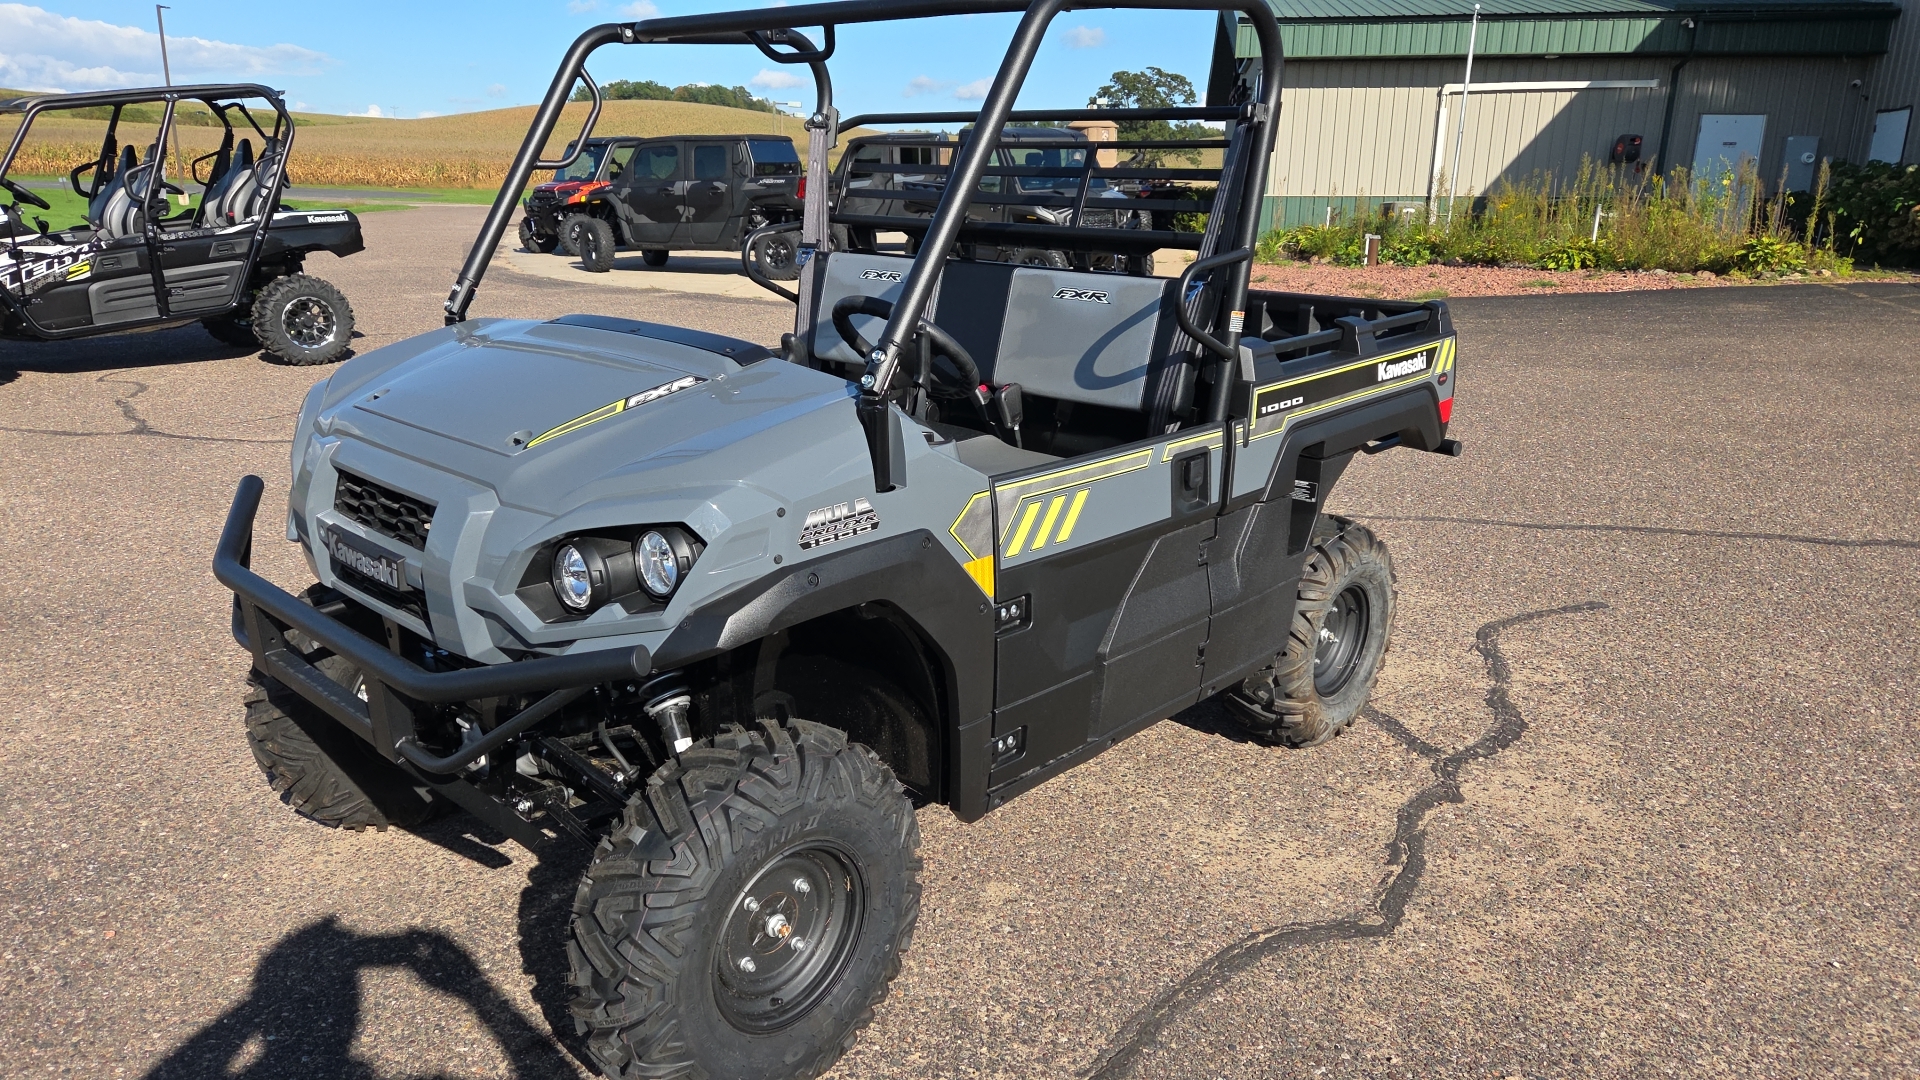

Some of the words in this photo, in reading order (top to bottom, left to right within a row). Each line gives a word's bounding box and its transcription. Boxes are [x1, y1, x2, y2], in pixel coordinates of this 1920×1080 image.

[306, 213, 349, 224] Kawasaki
[859, 269, 904, 283] FXR
[1052, 286, 1111, 304] FXR
[1377, 351, 1427, 382] Kawasaki
[626, 375, 705, 409] FXR
[1260, 396, 1304, 414] 1000
[327, 531, 399, 589] Kawasaki
